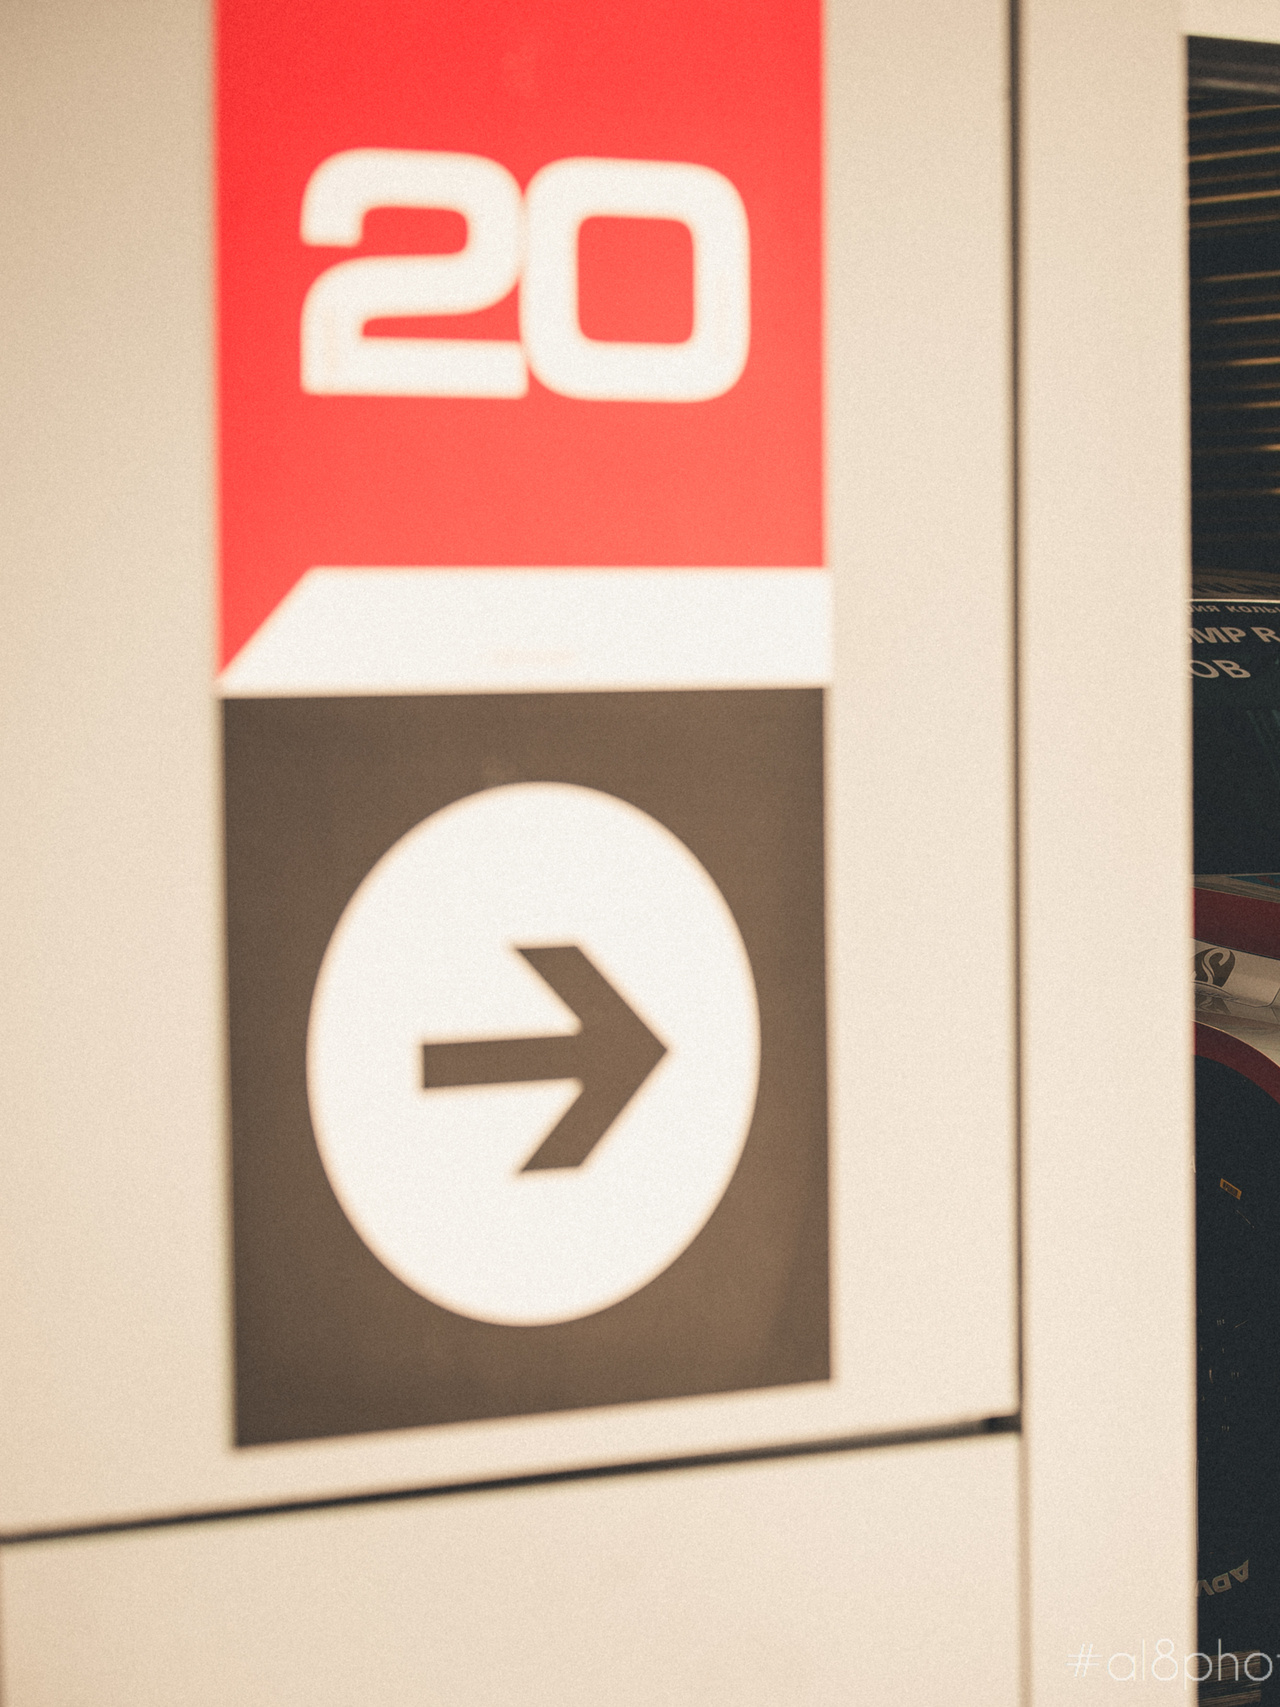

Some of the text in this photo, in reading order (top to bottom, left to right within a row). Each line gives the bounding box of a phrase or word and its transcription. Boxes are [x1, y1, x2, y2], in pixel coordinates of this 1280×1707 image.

[300, 147, 751, 403] 20
[1189, 626, 1247, 644] MP
[1198, 1560, 1249, 1596] ADV
